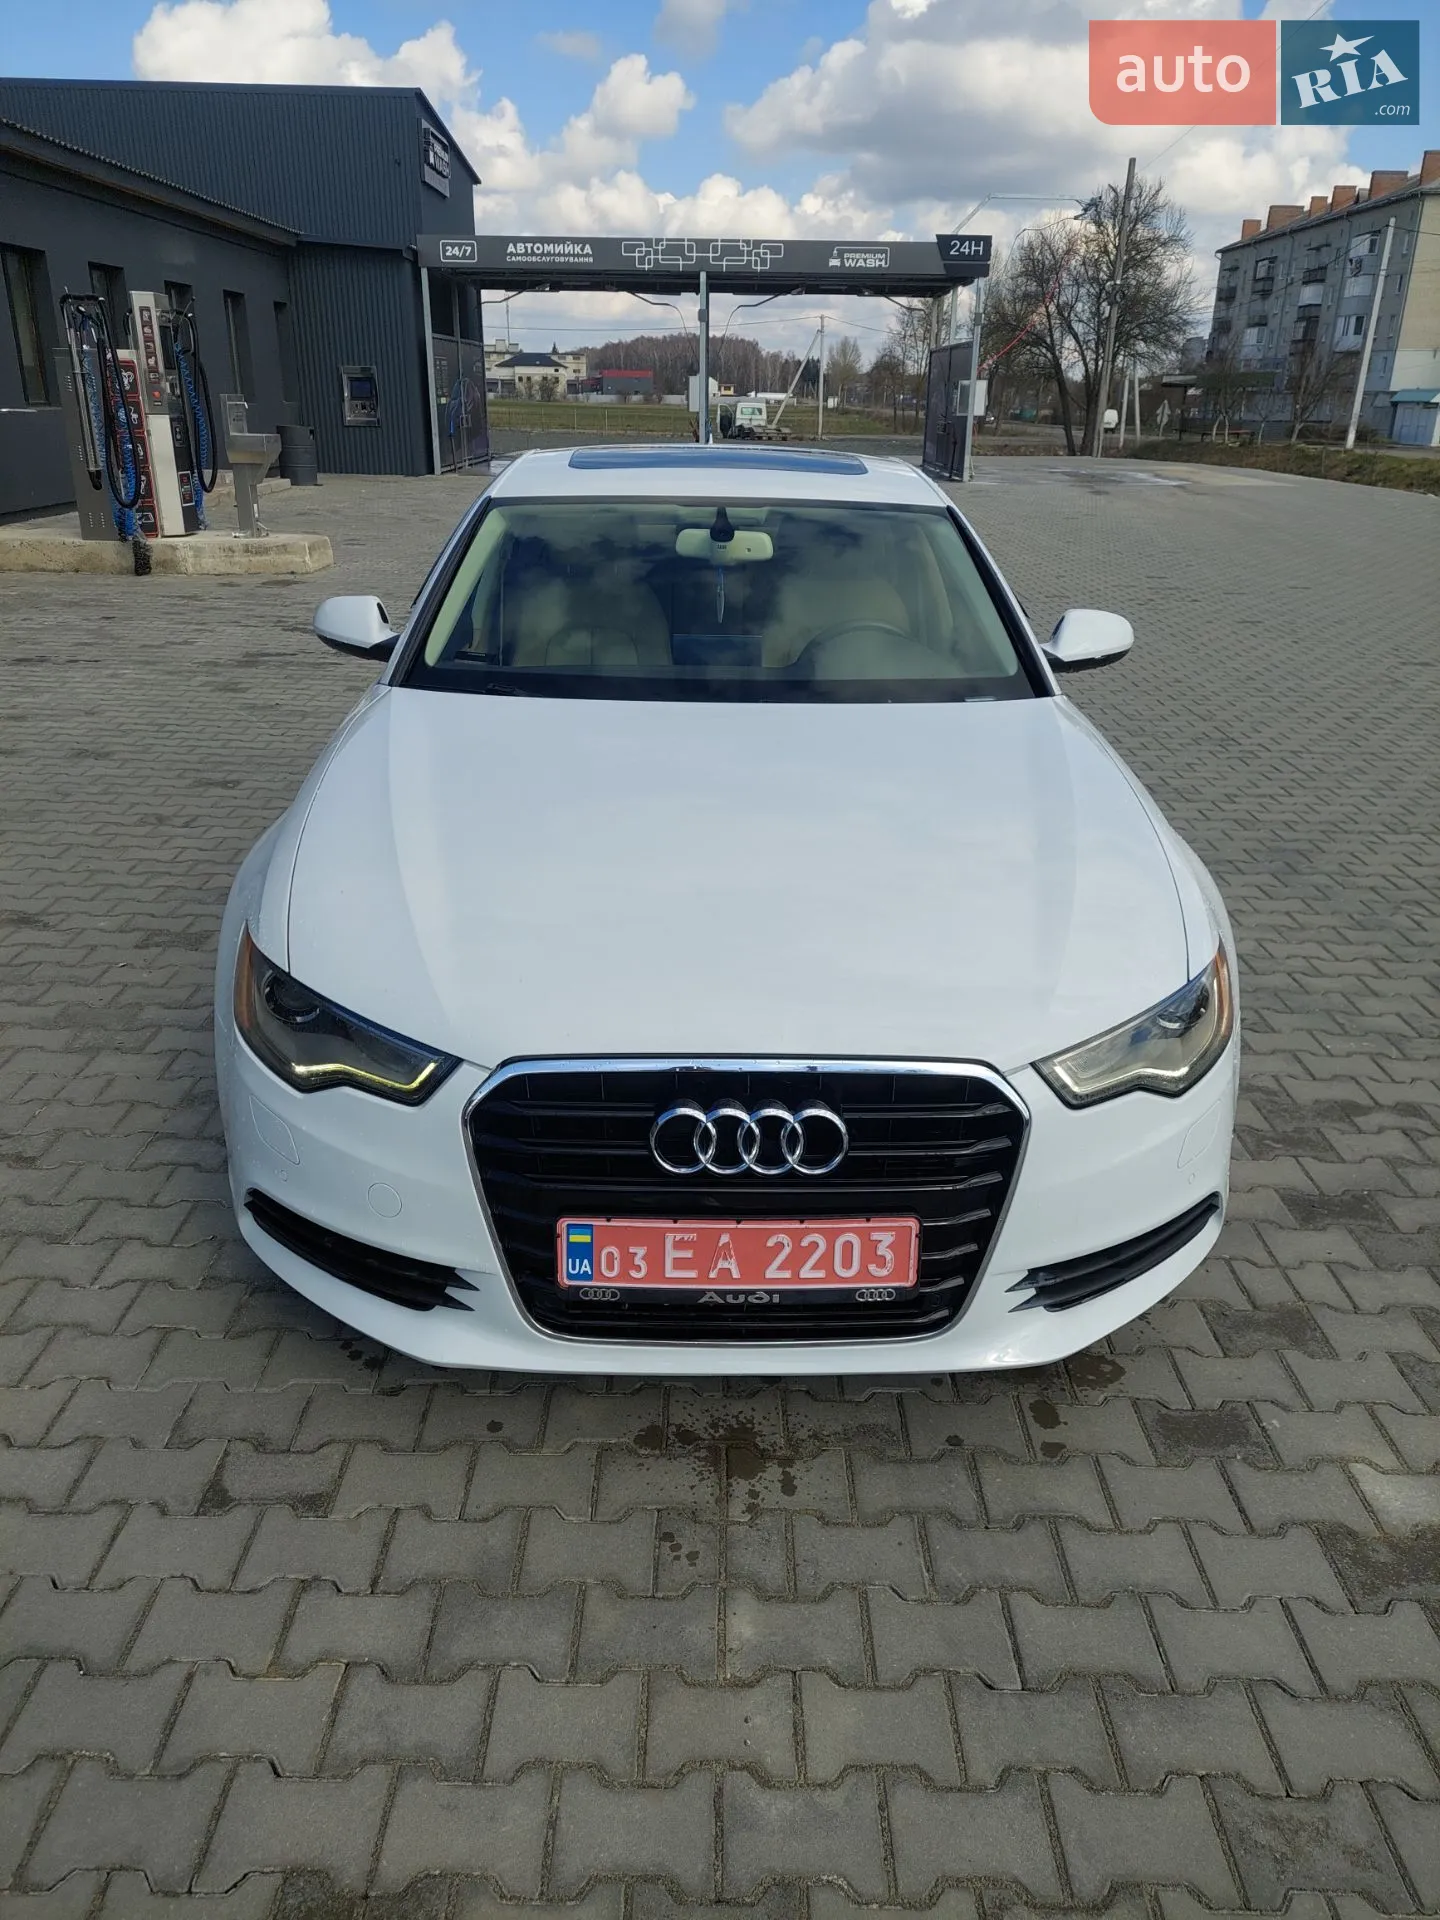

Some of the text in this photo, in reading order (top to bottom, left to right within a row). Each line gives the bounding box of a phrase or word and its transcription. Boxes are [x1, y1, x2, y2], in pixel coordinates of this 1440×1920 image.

[445, 246, 472, 257] 24/7
[506, 241, 593, 255] АВТОМИЙКА
[949, 240, 984, 256] 24H
[506, 255, 594, 263] САМООБСЛУГОВУВАННЯ
[844, 259, 886, 267] WASH
[600, 1232, 896, 1279] 03 EA 2203
[568, 1258, 592, 1275] UA
[697, 1291, 780, 1304] Audi
